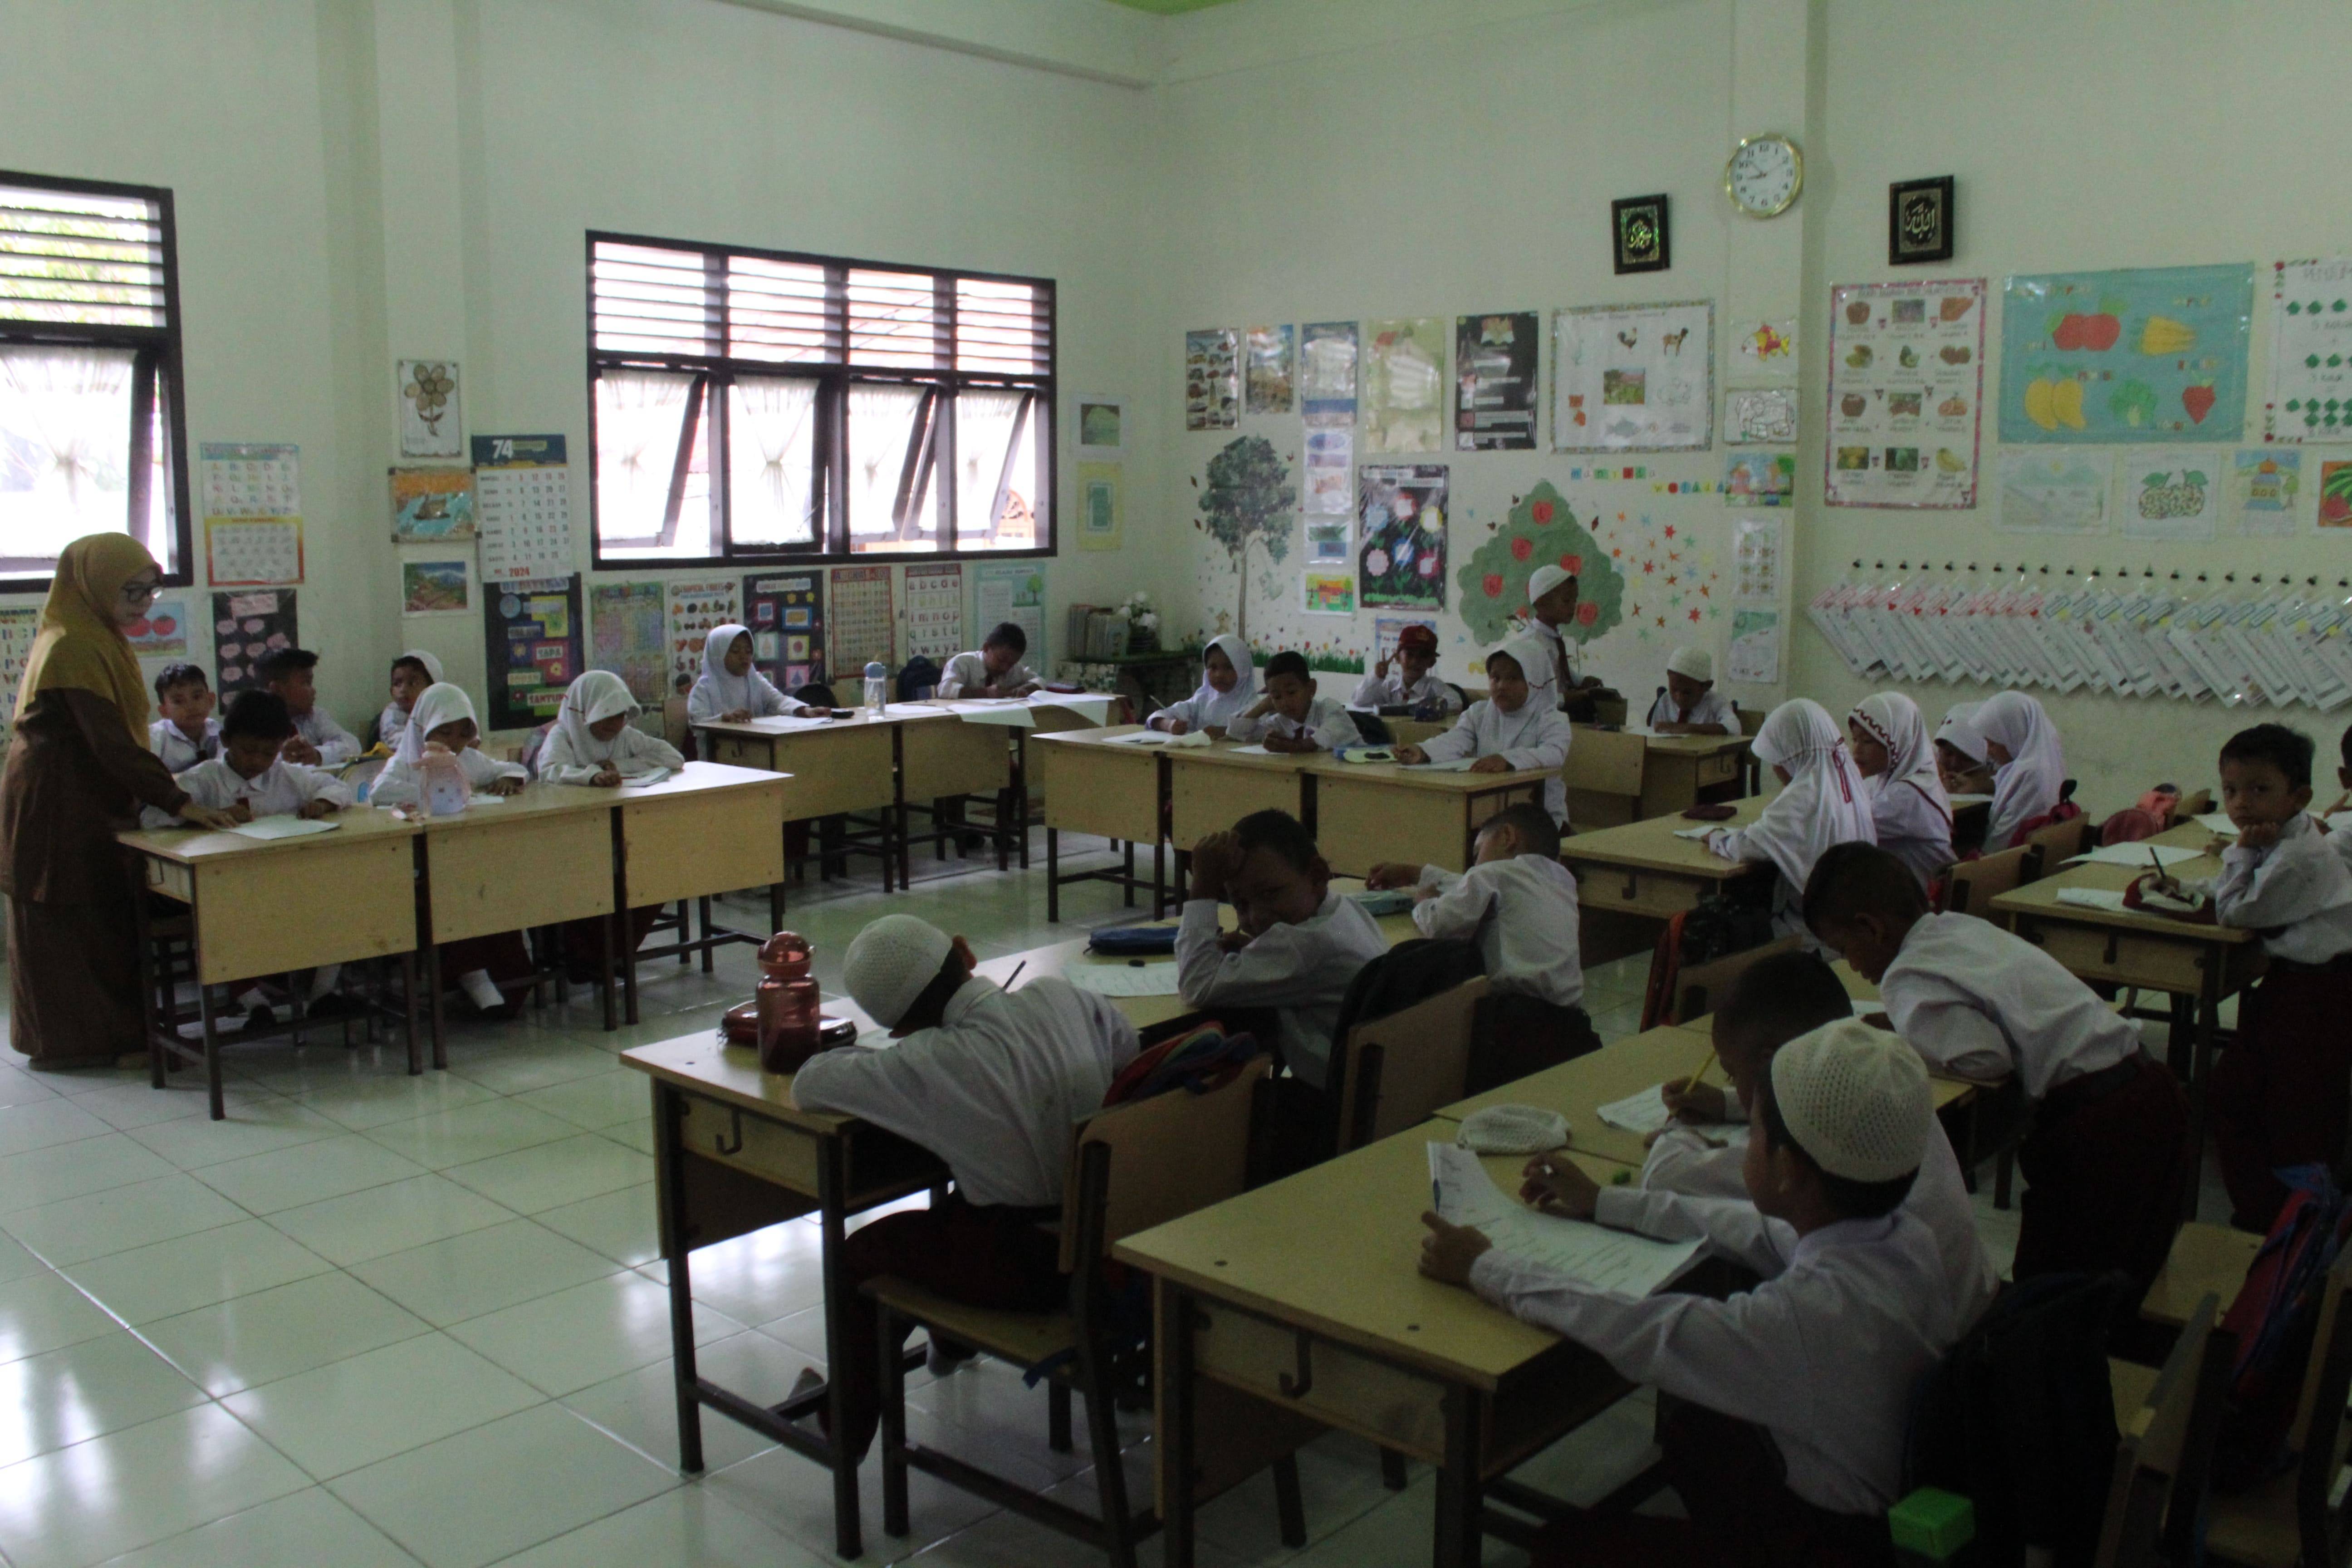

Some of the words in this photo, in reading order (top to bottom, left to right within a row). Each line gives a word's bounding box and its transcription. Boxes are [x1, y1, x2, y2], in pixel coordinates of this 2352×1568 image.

[1759, 143, 1769, 152] 12
[1748, 149, 1754, 158] 11
[1783, 156, 1788, 164] 2
[1739, 161, 1748, 169] 10
[1786, 168, 1793, 177] 3
[1736, 174, 1742, 182] 9
[1749, 195, 1755, 203] 7
[1774, 194, 1780, 202] 5
[493, 439, 513, 459] 74
[533, 473, 539, 481] 12
[509, 567, 530, 577] 2024
[909, 581, 915, 590] a
[920, 578, 926, 590] b
[931, 580, 936, 588] c
[919, 613, 928, 622] m
[933, 612, 939, 621] n
[943, 612, 950, 620] o
[953, 611, 958, 622] p
[910, 630, 916, 642] q
[932, 627, 938, 637] s
[952, 626, 958, 634] u
[537, 648, 562, 658] SAPA
[911, 647, 916, 655] v
[921, 646, 930, 654] w
[944, 644, 949, 655] y
[953, 643, 959, 652] z
